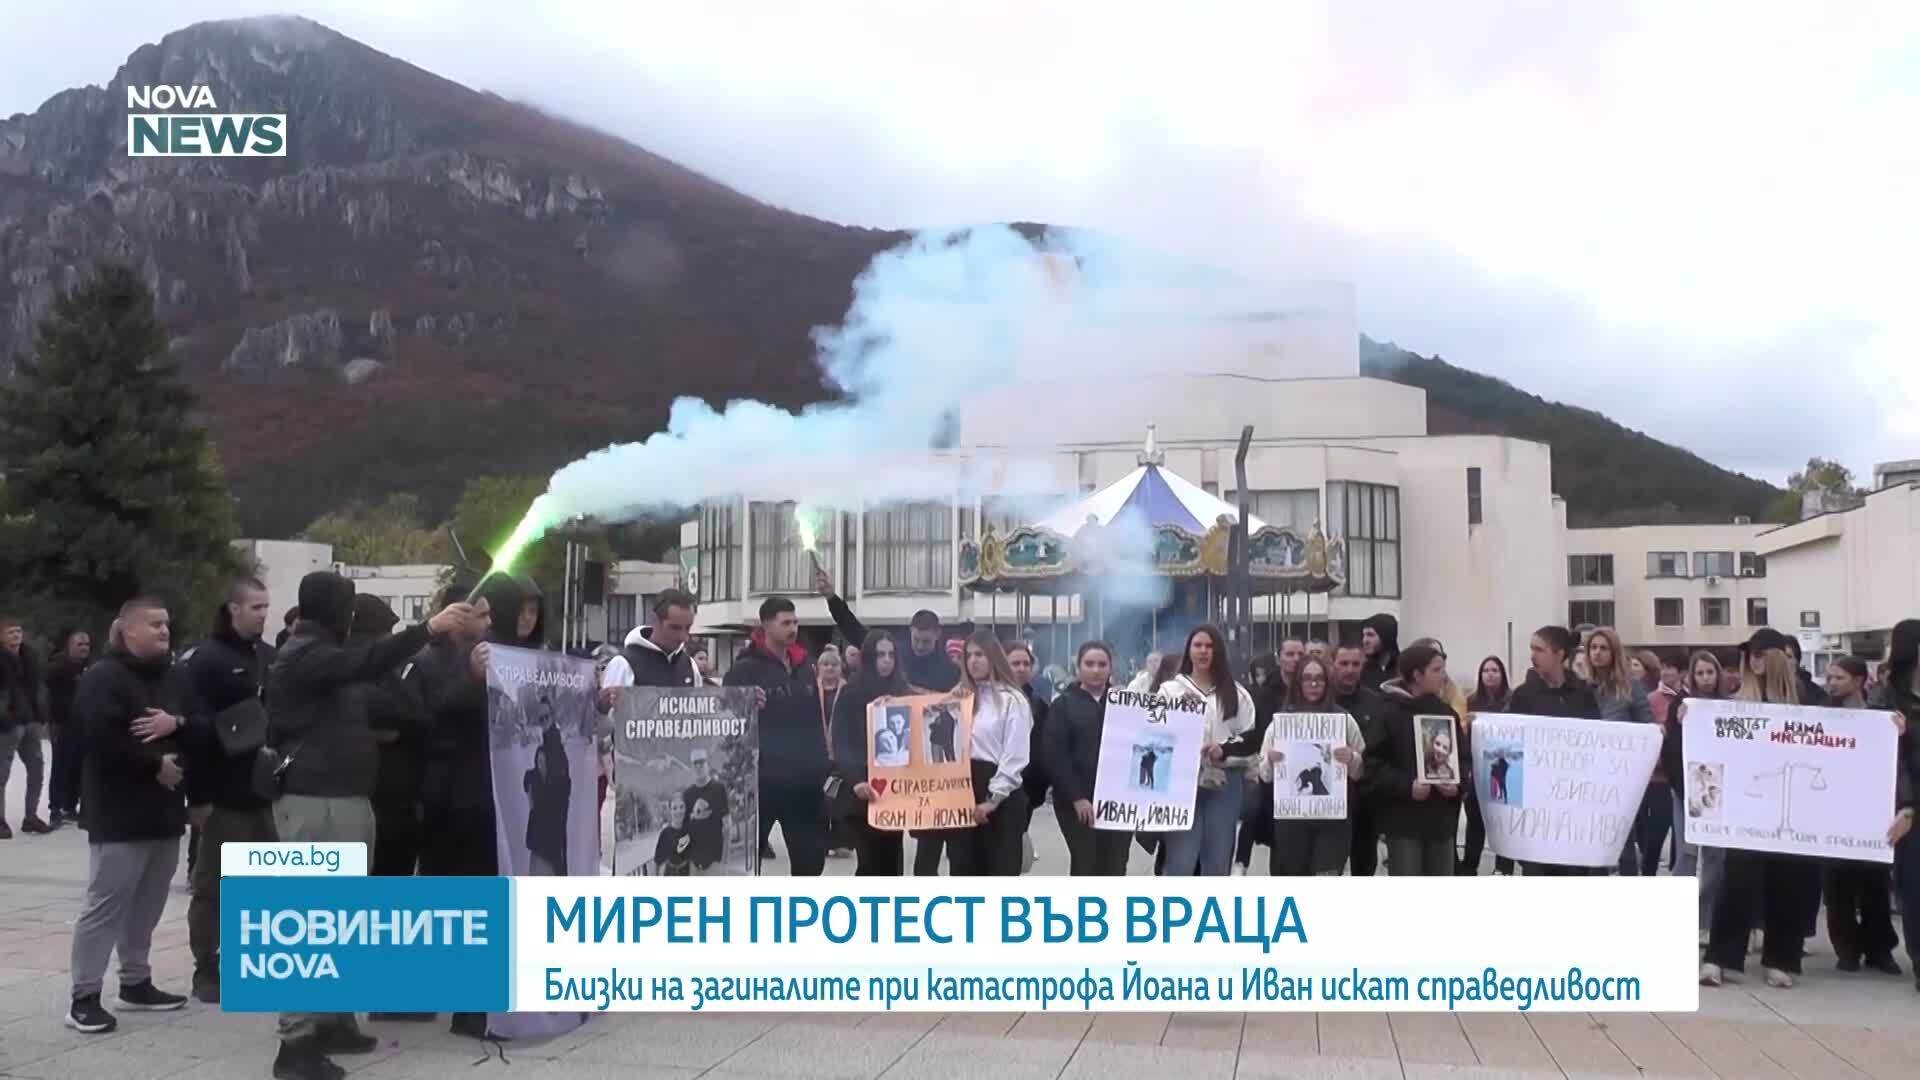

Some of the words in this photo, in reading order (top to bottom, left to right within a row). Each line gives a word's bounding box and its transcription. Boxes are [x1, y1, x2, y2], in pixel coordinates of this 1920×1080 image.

[496, 664, 585, 689] СПРАВЕДЛИВОСТ
[659, 696, 716, 715] ИСКАМЕ
[625, 718, 747, 739] СПРАВЕДЛИВОСТ
[1096, 799, 1138, 825] ИВАН
